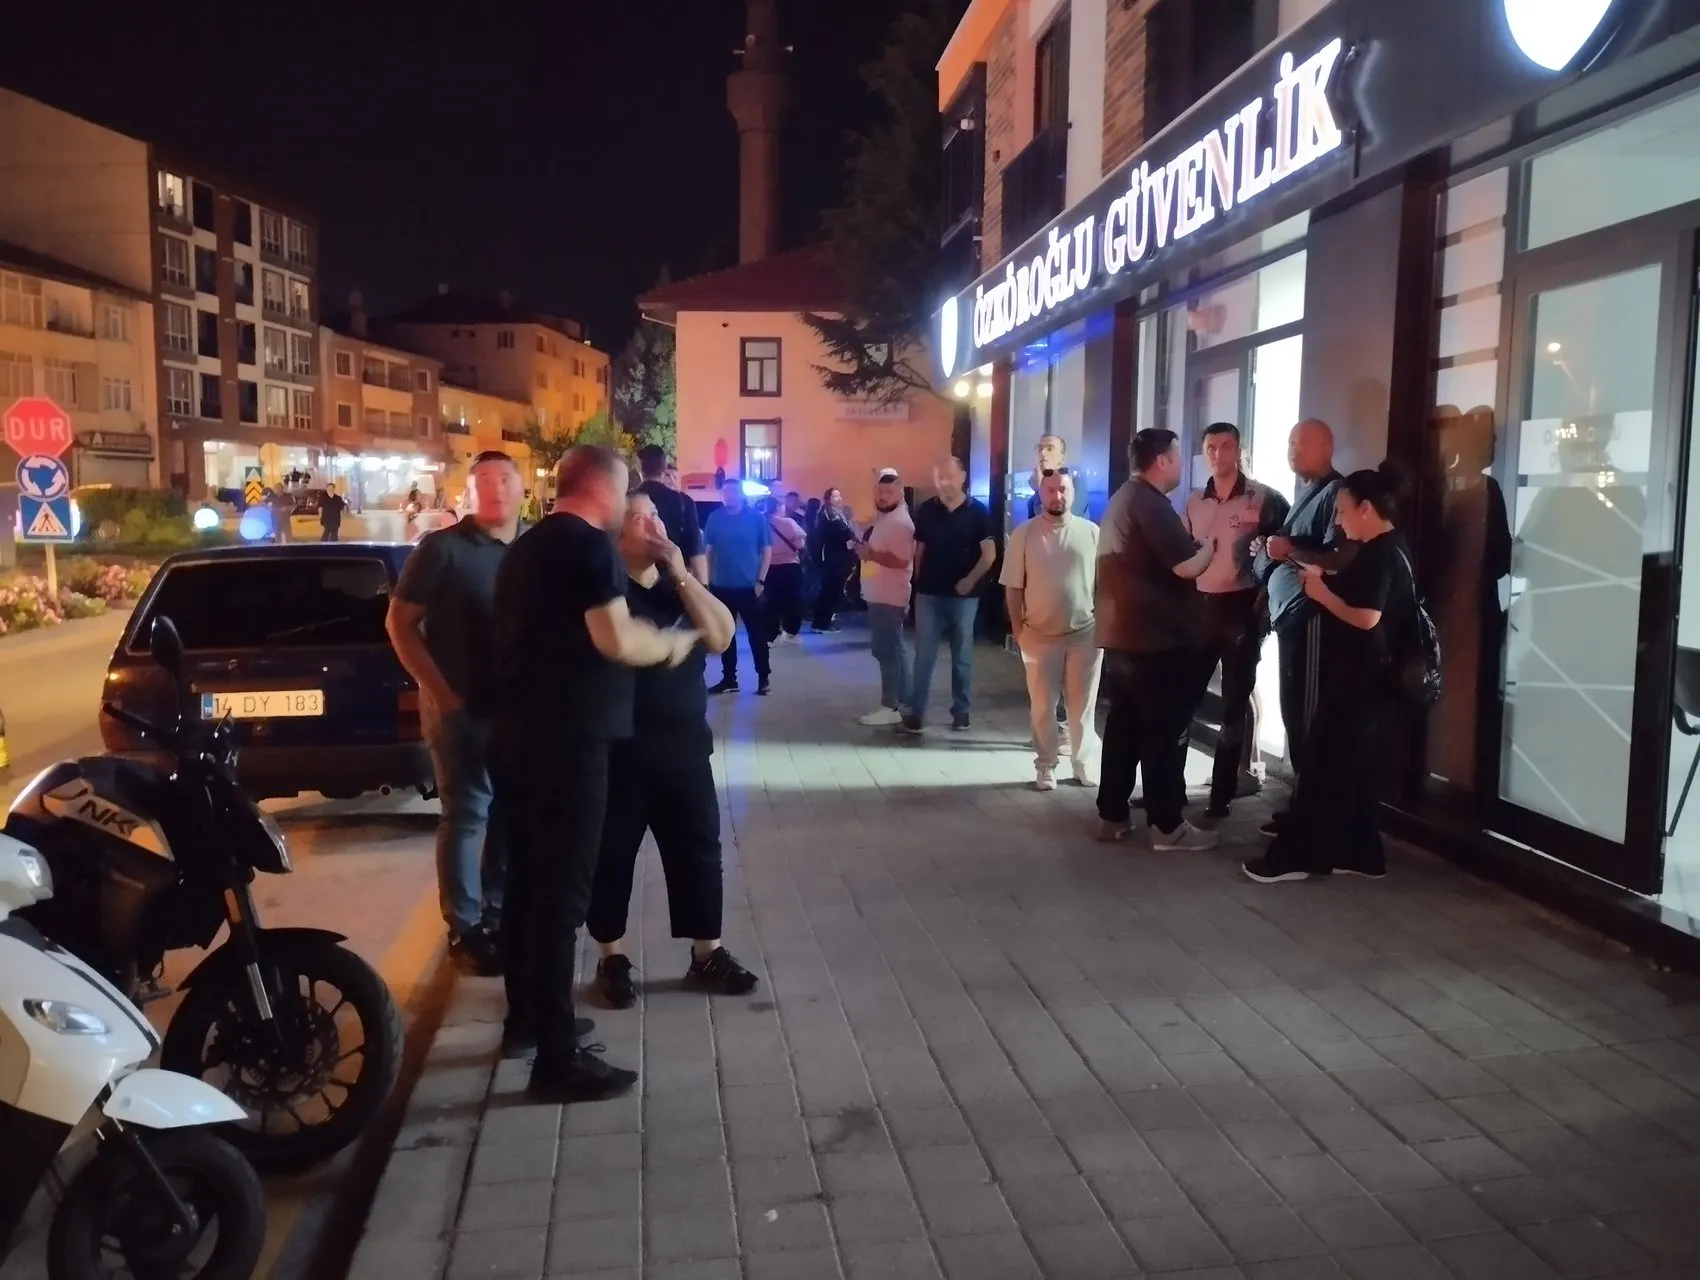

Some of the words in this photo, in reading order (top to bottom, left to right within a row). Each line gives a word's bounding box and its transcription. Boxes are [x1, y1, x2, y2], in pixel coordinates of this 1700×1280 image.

[1104, 37, 1342, 275] GÜVENLİK
[9, 416, 66, 441] DUR
[215, 697, 232, 714] 14
[244, 696, 271, 713] DY
[284, 694, 318, 712] 183
